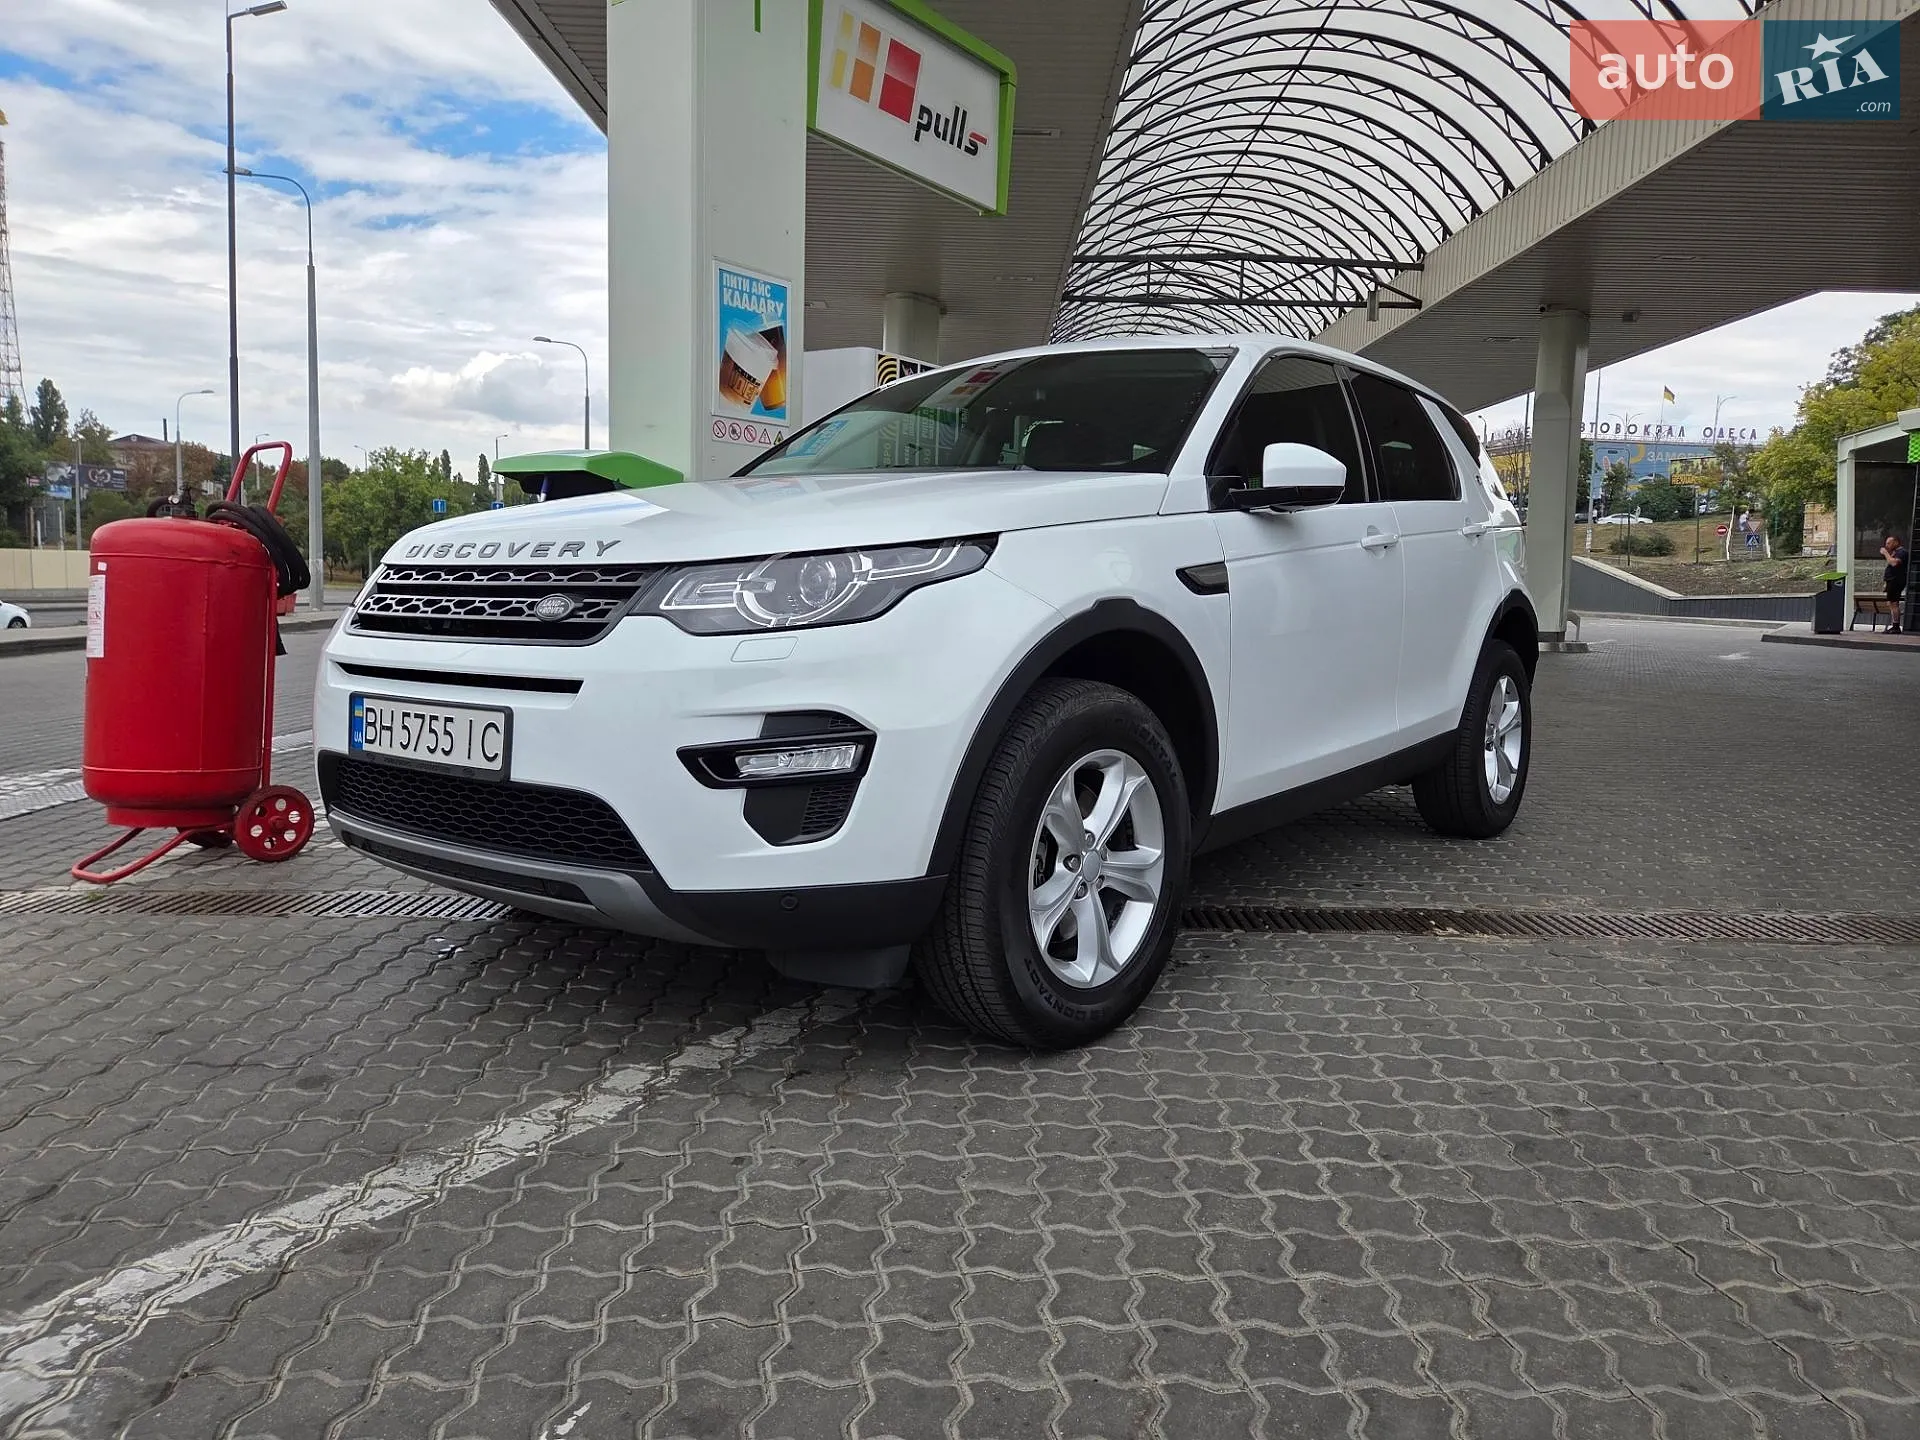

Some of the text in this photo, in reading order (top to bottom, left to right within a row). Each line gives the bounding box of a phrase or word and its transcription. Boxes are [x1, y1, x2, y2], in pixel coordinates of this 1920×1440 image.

[914, 104, 987, 156] pulls
[722, 272, 750, 293] ПИТИ
[1580, 421, 1757, 440] ВТОВОКЗАЛ ОДЕСА
[405, 540, 621, 559] DISCOVERY
[354, 731, 363, 743] UA
[365, 706, 501, 762] BH 5755 IC
